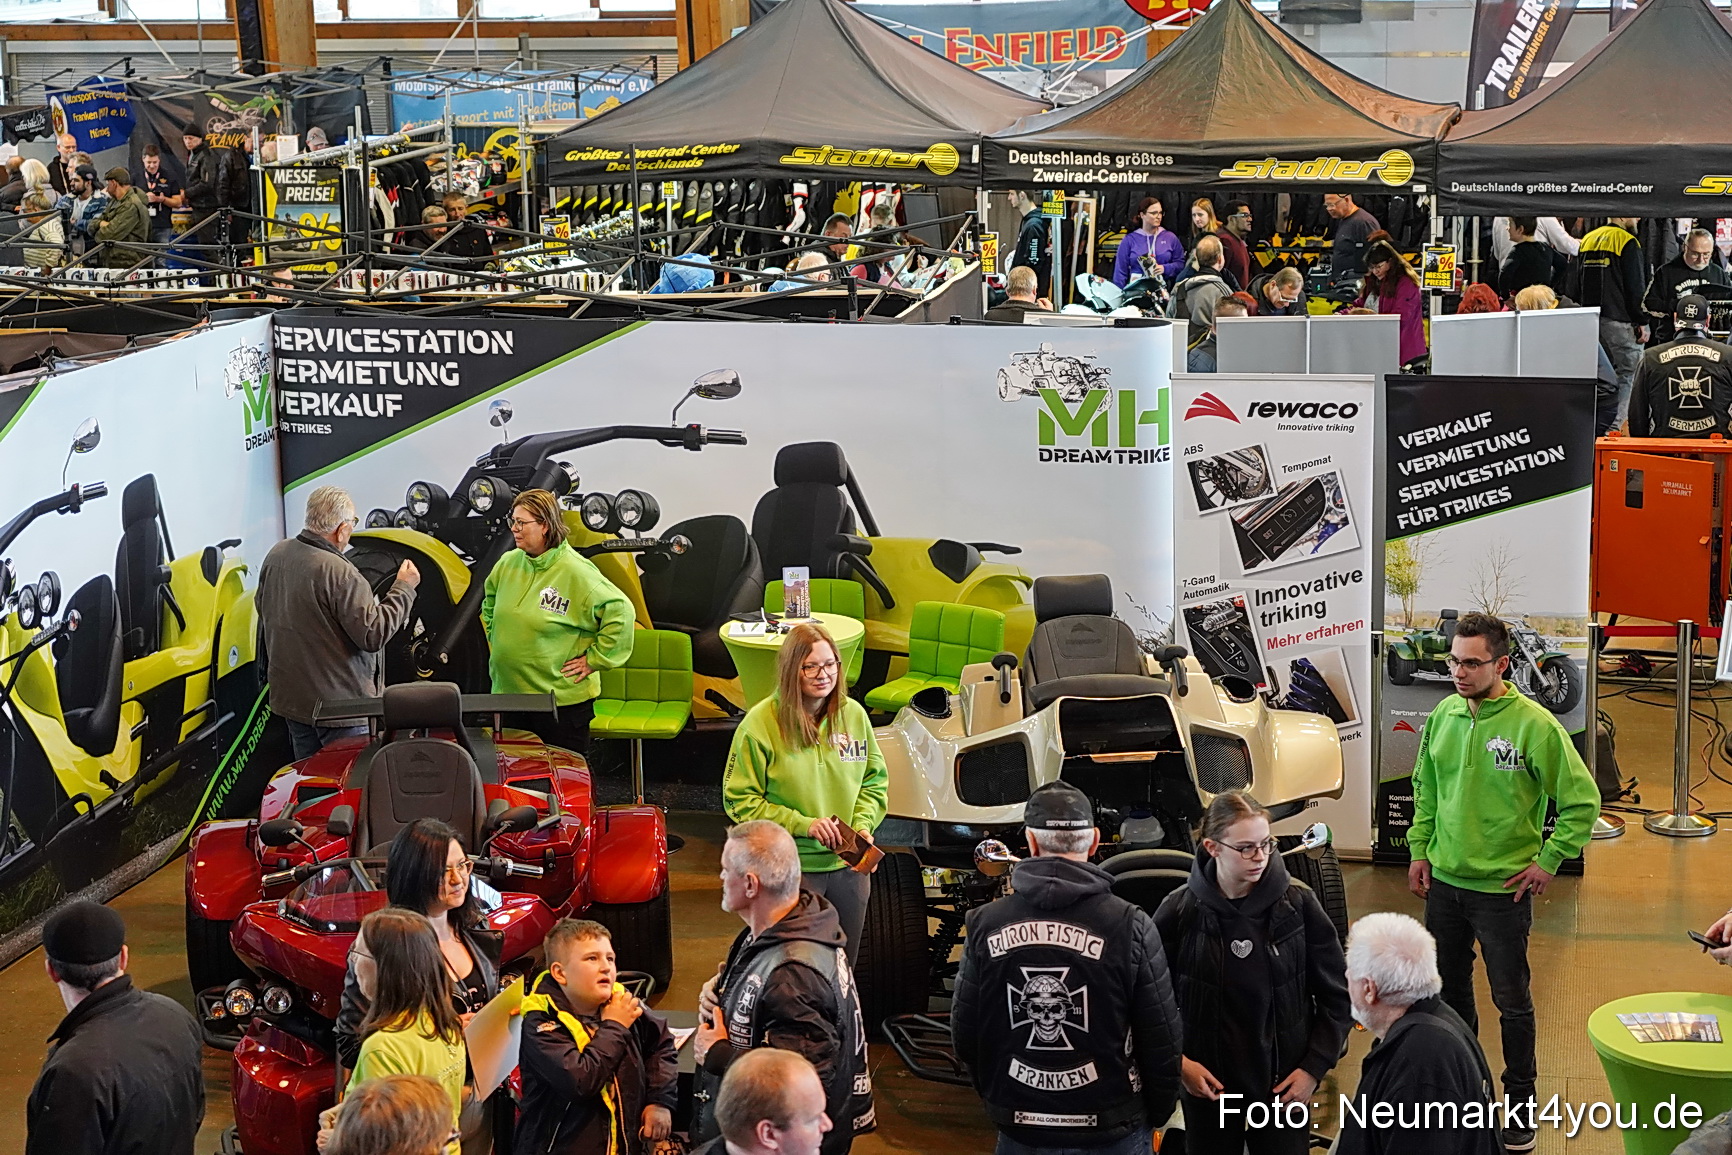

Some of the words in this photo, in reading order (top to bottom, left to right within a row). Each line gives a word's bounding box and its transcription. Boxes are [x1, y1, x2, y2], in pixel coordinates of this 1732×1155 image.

[944, 26, 1128, 72] ENFIELD
[1484, 0, 1546, 92] TRAILER
[564, 147, 623, 161] Größtes
[779, 144, 940, 169] stadler
[1008, 149, 1111, 166] Deutschlands
[1115, 152, 1174, 168] größtes
[274, 169, 317, 184] MESSE
[1032, 168, 1150, 184] Zweirad-Center
[1219, 157, 1390, 181] stadler
[285, 186, 336, 202] PREISE!
[1451, 181, 1524, 193] Deutschlands
[1526, 182, 1568, 194] größtes
[1570, 183, 1654, 194] Zweirad-Center
[982, 241, 997, 257] %
[1439, 255, 1454, 271] %
[1425, 272, 1451, 280] MESSE
[1425, 279, 1452, 287] PREISE
[1670, 345, 1710, 356] TRUST
[1037, 386, 1170, 448] MH
[1669, 416, 1714, 431] GERMANY
[291, 422, 332, 434] TRIKES
[1277, 423, 1324, 432] Innovative
[1325, 423, 1355, 434] triking
[1398, 411, 1493, 449] VERKAUF
[1038, 447, 1171, 465] DREAMTRIKE
[1183, 443, 1205, 457] ABS
[1398, 427, 1531, 476] VERMIETUNG
[1281, 454, 1332, 474] Tempomat
[1398, 445, 1566, 503] SERVICESTATION
[1660, 481, 1693, 490] JURAHALLE
[1662, 488, 1692, 496] NEUMARKT
[1396, 506, 1439, 529] FÜR
[1439, 485, 1513, 518] TRIKES
[1262, 528, 1275, 540] SET
[1182, 573, 1217, 587] 7-Gang
[1255, 569, 1364, 606] Innovative
[1183, 582, 1231, 600] Automatik
[541, 593, 569, 612] MH
[1260, 600, 1327, 628] triking
[1266, 634, 1302, 650] Mehr
[1305, 619, 1365, 641] erfahren
[1390, 709, 1418, 717] Partner
[839, 740, 867, 757] MH
[990, 938, 1003, 954] M
[1005, 923, 1040, 947] IRON
[1046, 923, 1084, 947] FIST
[1087, 939, 1102, 956] C
[1015, 1063, 1090, 1089] FRANKEN
